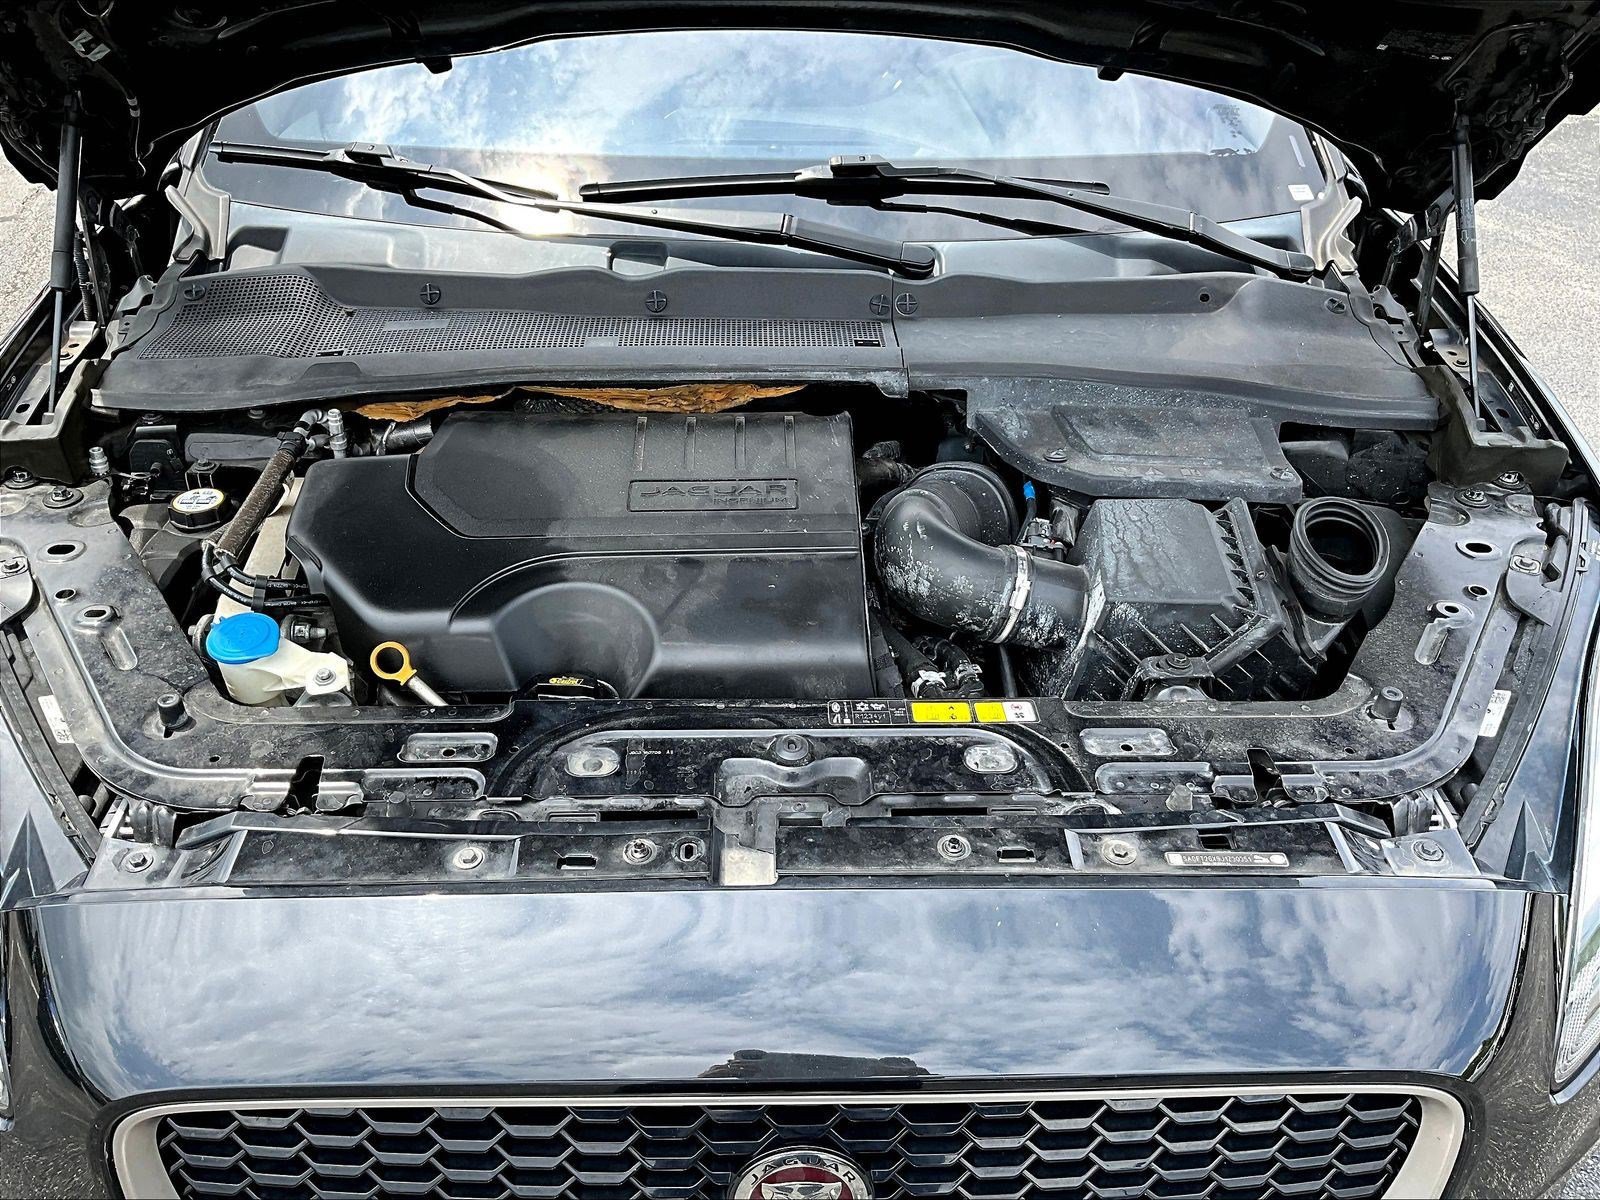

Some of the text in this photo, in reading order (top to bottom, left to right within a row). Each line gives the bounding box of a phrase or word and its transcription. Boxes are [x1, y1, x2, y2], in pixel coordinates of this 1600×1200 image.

[640, 484, 788, 497] JAGUAR
[713, 497, 788, 505] INGENIUM
[751, 1157, 857, 1186] JAGUAR
